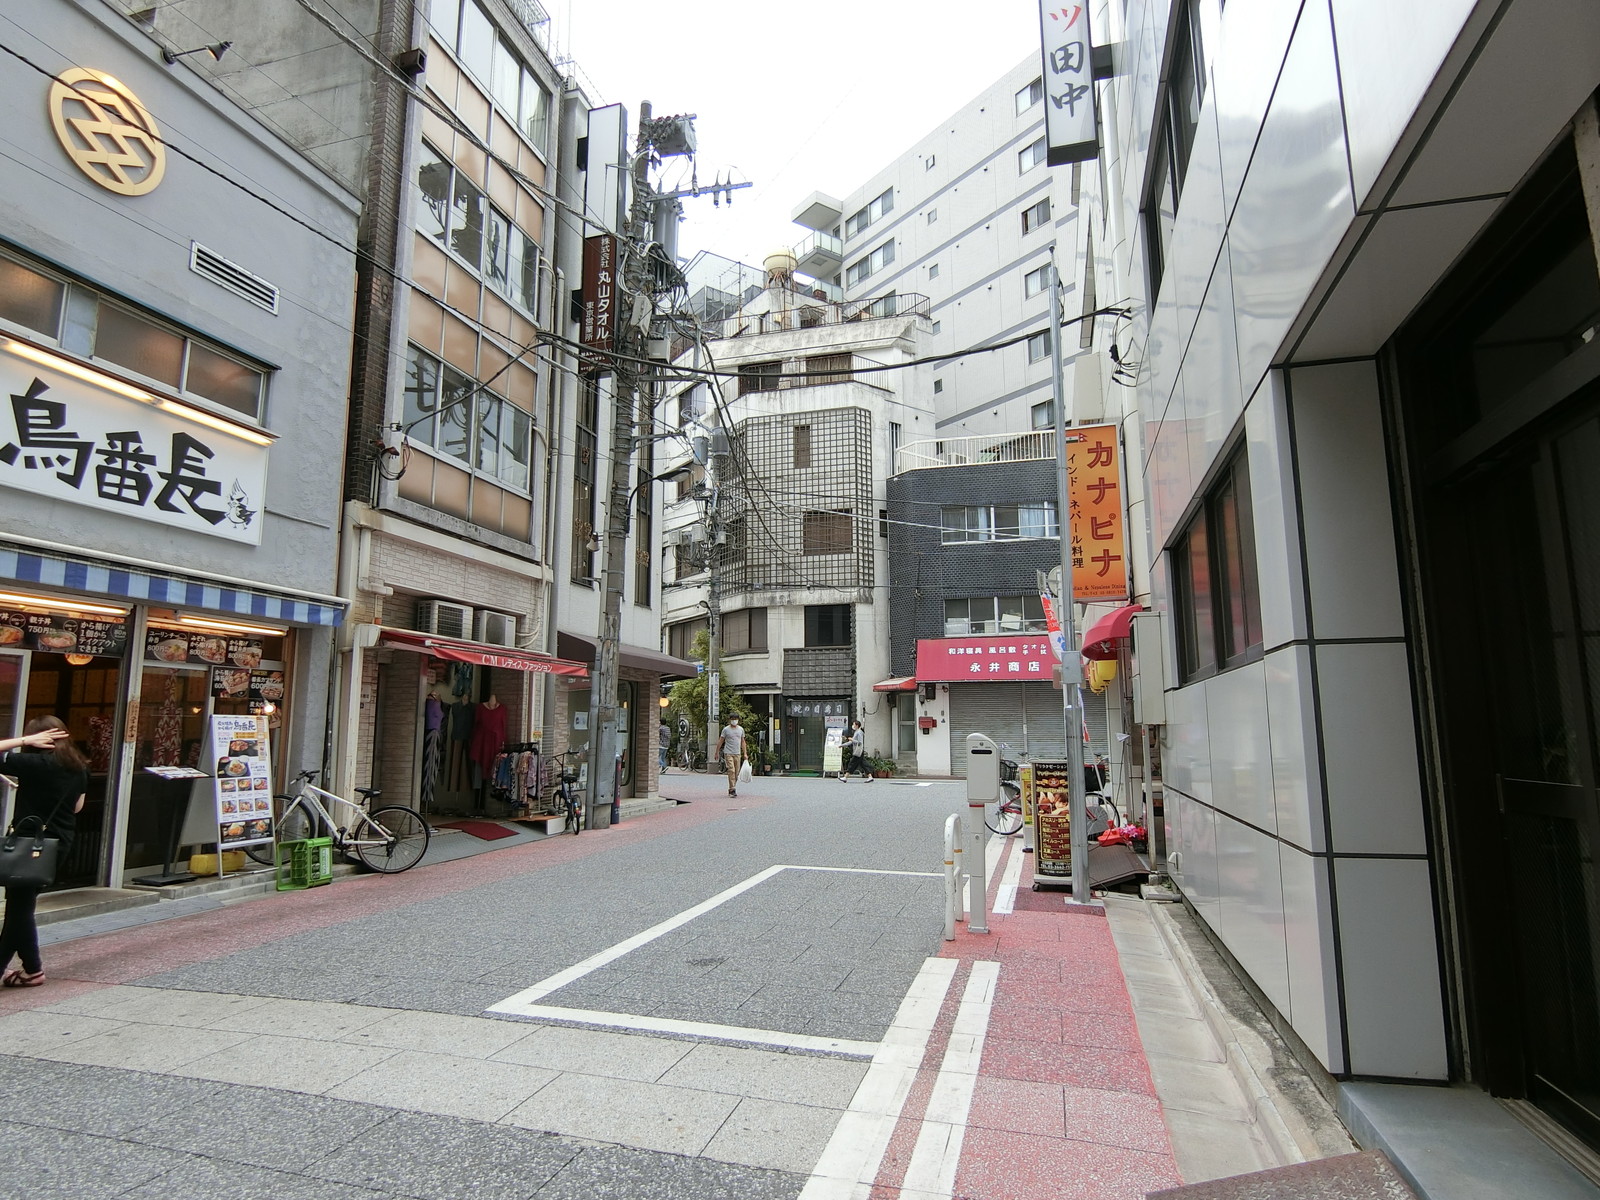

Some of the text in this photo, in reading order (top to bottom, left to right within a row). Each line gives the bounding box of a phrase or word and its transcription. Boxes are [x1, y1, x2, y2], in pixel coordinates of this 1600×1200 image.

[600, 237, 611, 269] 株式会社
[596, 270, 612, 341] 丸山タオル
[584, 301, 595, 342] 東京営業所
[0, 377, 226, 525] 鳥番長
[1067, 453, 1084, 569] インド・ネパール料理
[1086, 441, 1121, 578] カナピナ
[80, 621, 111, 631] から揚げ
[78, 645, 105, 654] できます
[79, 638, 117, 648] テイクアウト
[988, 646, 1017, 654] 風呂敷
[482, 654, 498, 666] CM
[970, 661, 1040, 673] 永井商店
